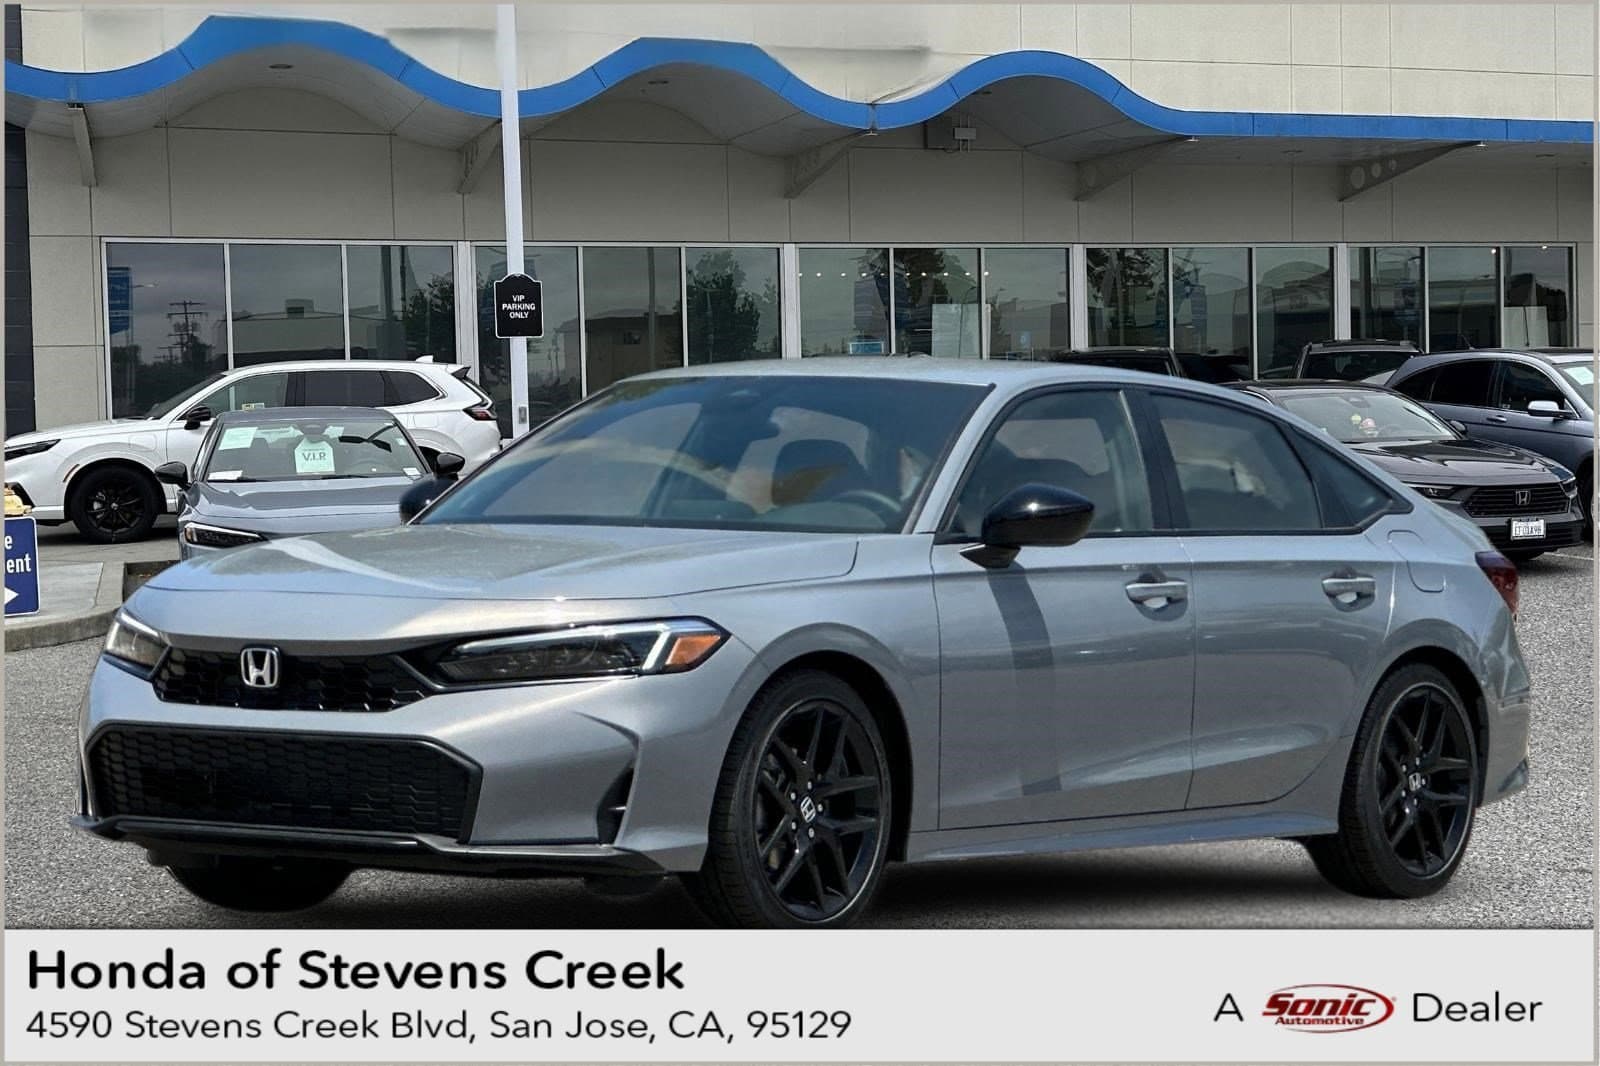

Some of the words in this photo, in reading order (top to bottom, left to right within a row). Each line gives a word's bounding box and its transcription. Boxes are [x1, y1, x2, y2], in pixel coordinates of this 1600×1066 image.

[512, 294, 525, 302] VIP
[509, 311, 529, 319] ONLY
[245, 648, 274, 687] H
